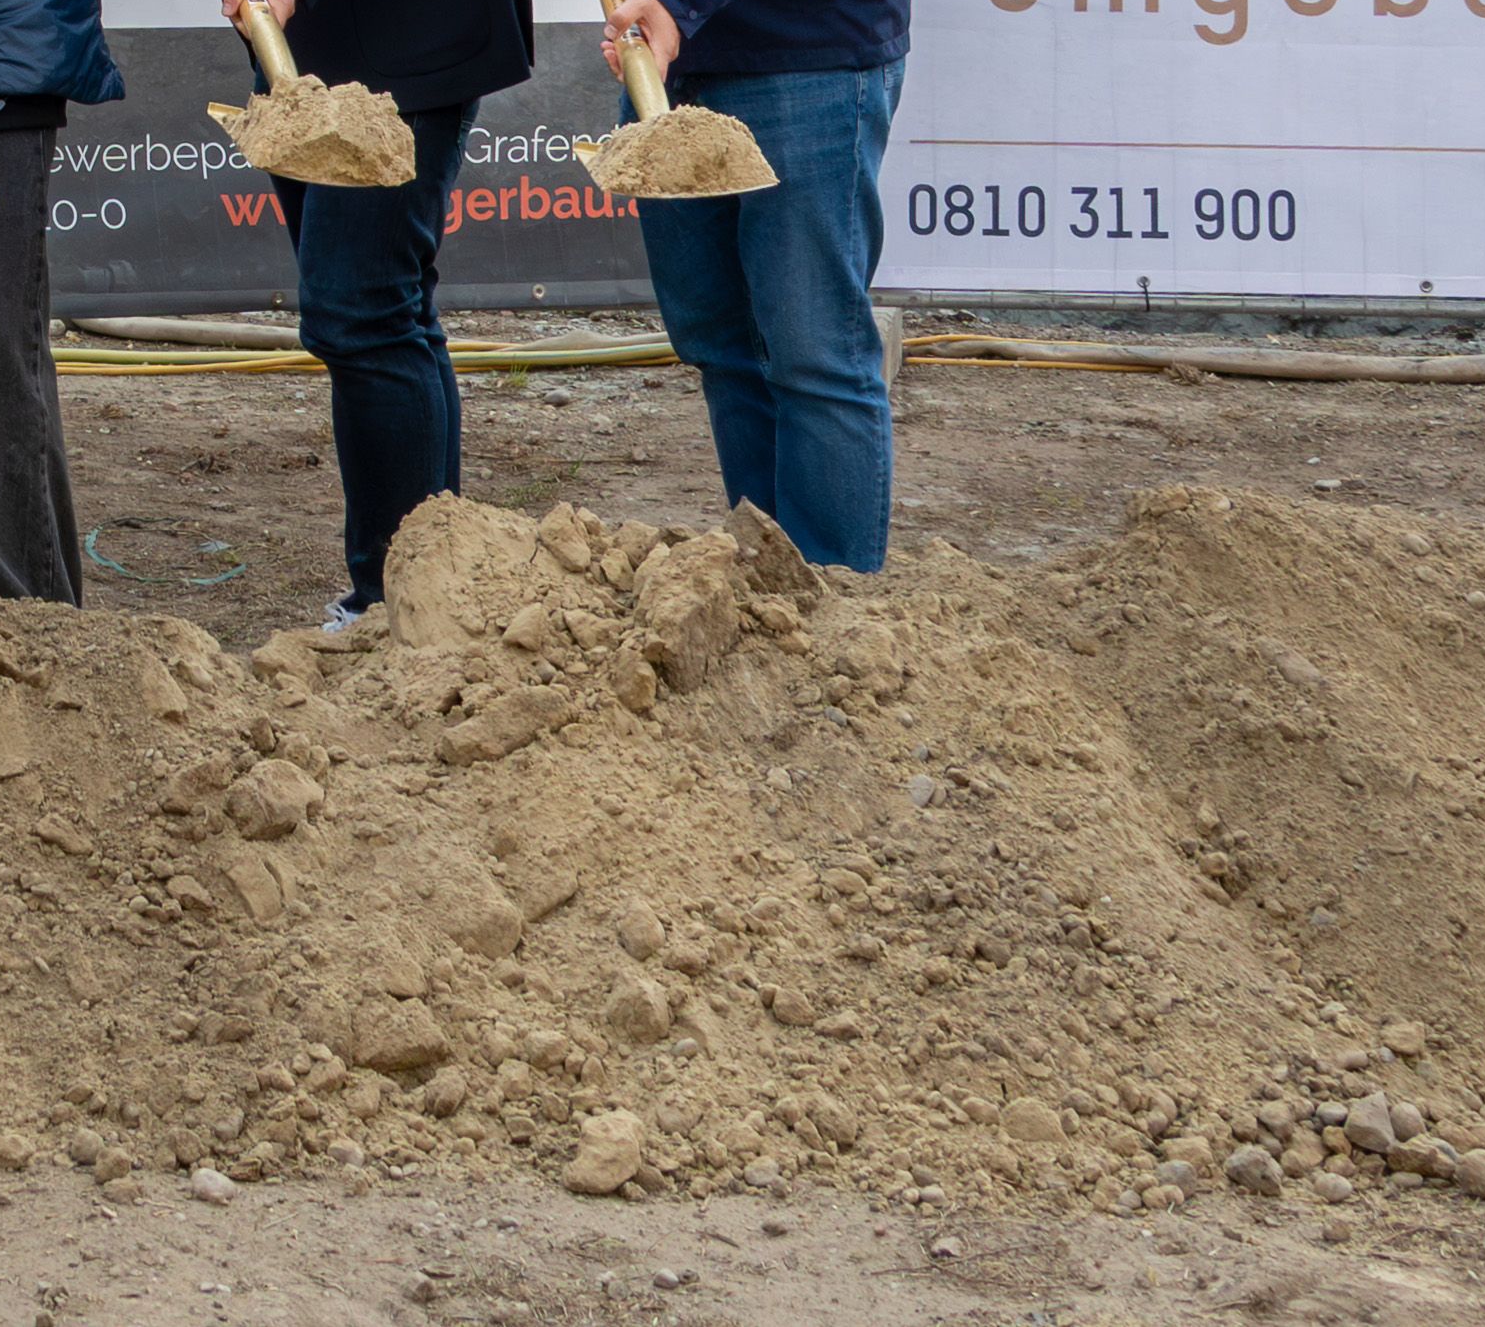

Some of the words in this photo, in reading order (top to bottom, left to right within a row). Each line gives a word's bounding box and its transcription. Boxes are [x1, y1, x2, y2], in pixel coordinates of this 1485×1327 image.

[50, 133, 254, 180] ewerbepa
[45, 198, 126, 231] 0-0
[909, 184, 1045, 237] 0810
[1070, 187, 1169, 239] 311
[1195, 189, 1296, 241] 900
